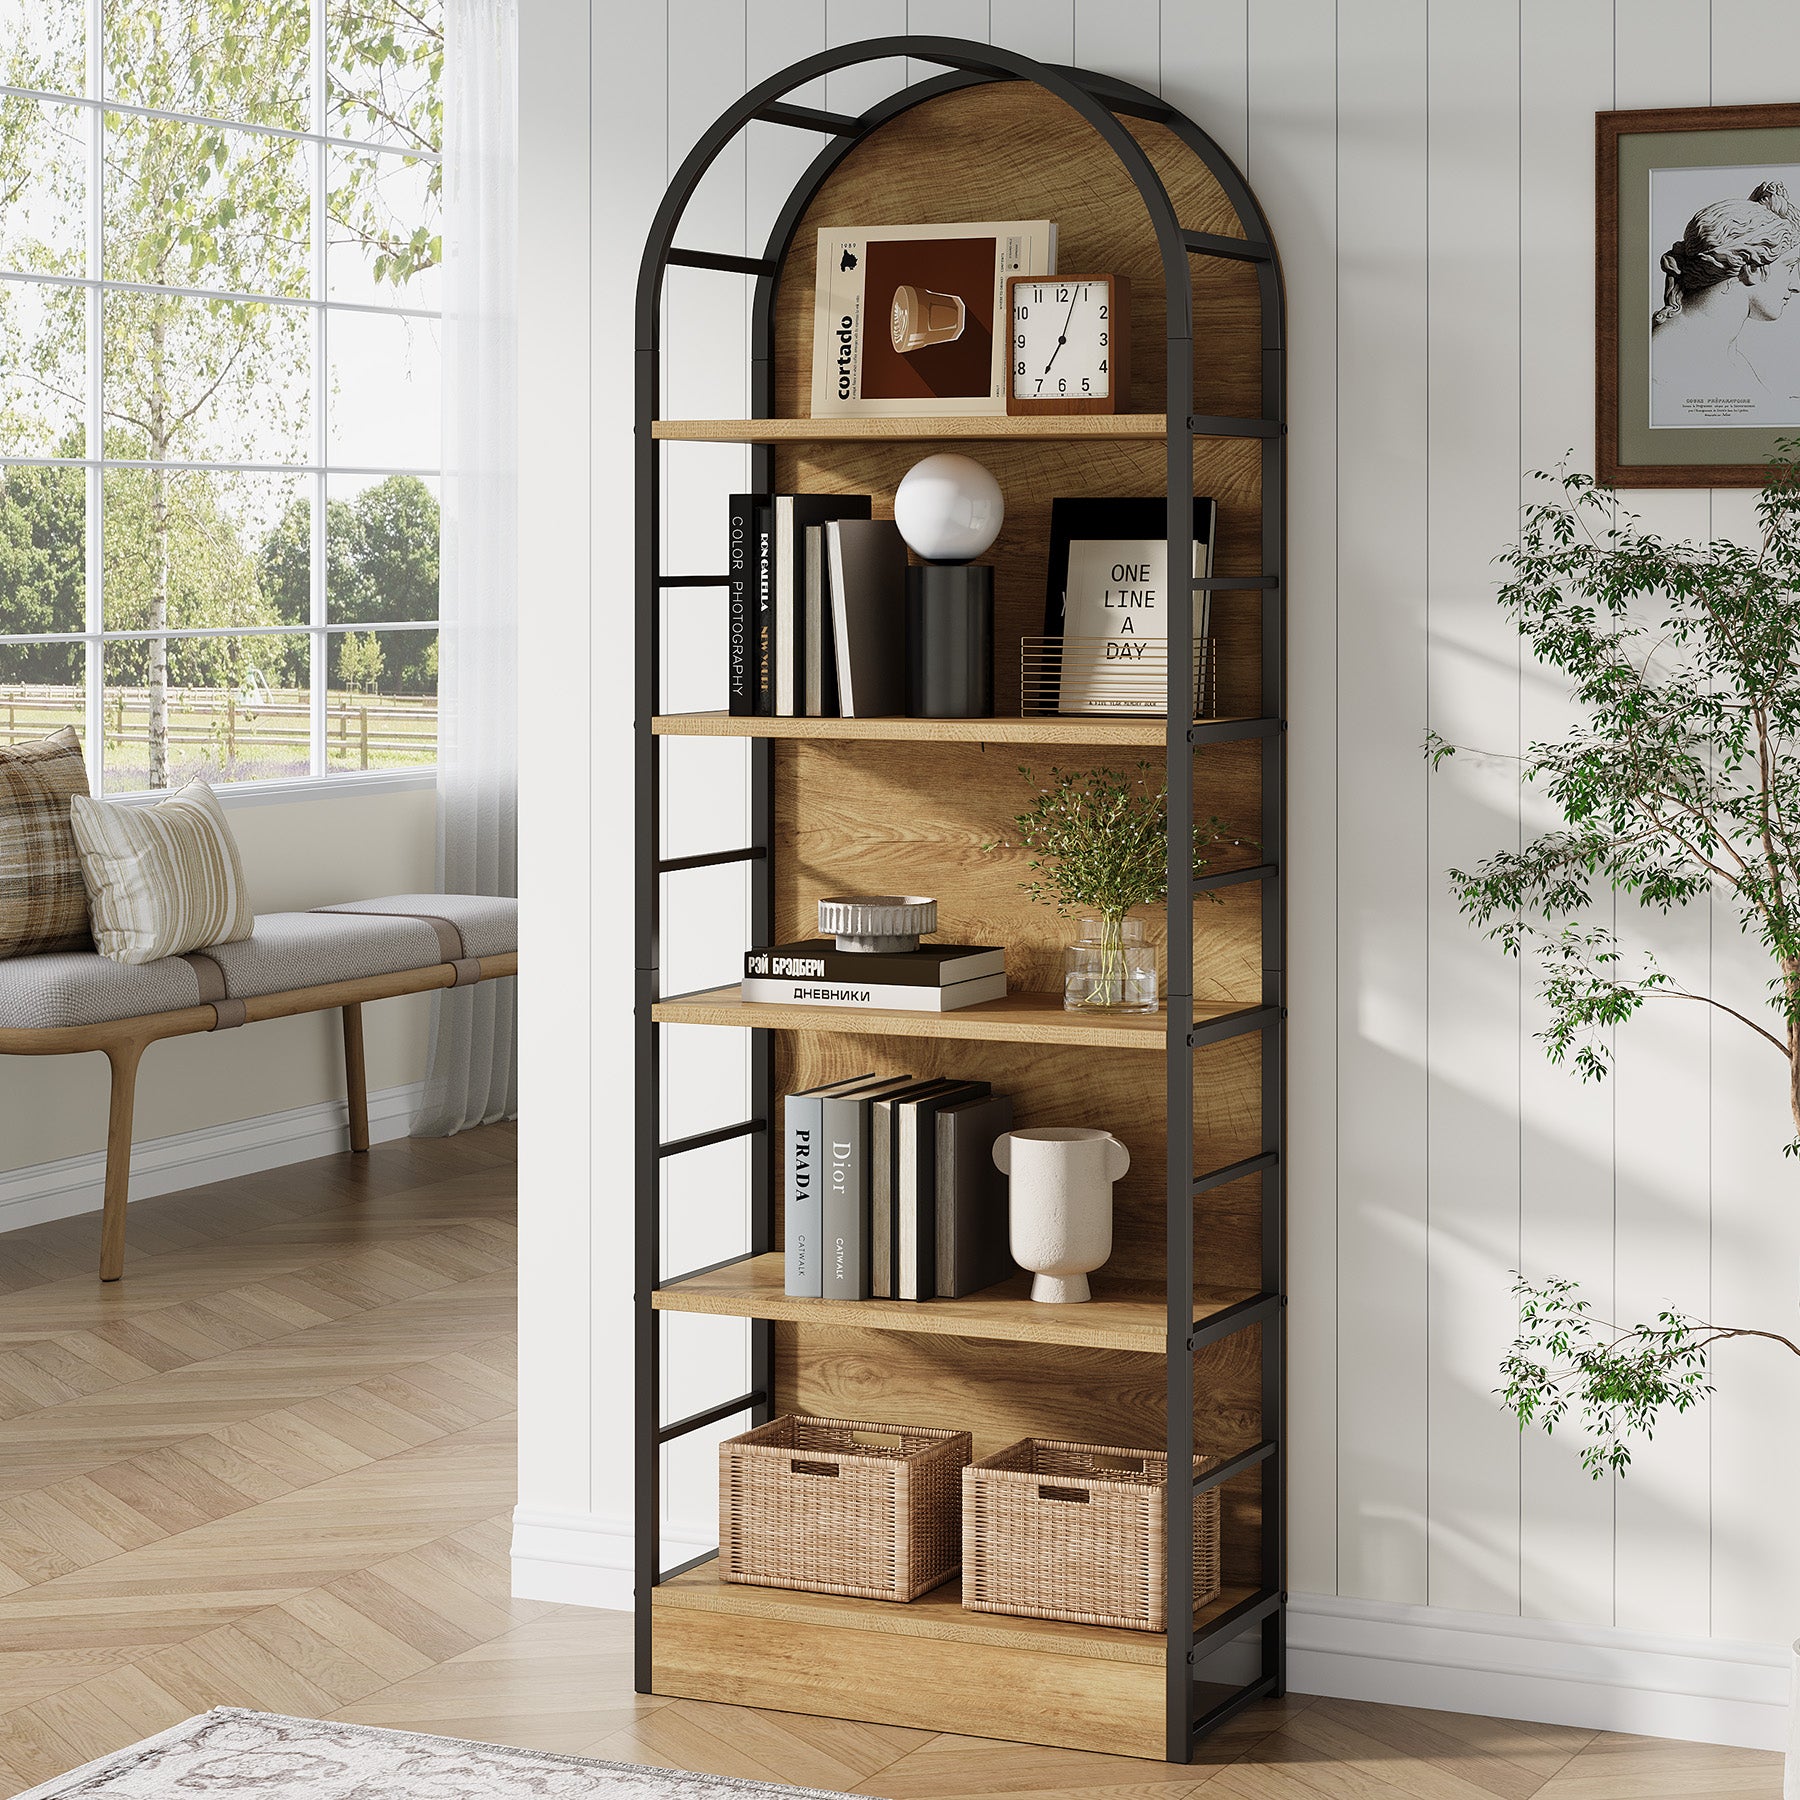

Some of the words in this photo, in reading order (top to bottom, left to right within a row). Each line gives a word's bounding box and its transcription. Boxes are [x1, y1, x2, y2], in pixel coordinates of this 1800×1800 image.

[1033, 288, 1043, 303] 11
[1056, 288, 1069, 303] 12
[1083, 288, 1088, 302] 1
[1017, 307, 1029, 321] 10
[1099, 305, 1108, 320] 2
[1017, 334, 1026, 349] 9
[1099, 332, 1108, 347] 3
[836, 315, 853, 400] cortado
[1099, 359, 1108, 374] 4
[1017, 362, 1026, 376] 8
[1035, 378, 1044, 393] 7
[1058, 378, 1067, 393] 6
[1081, 378, 1090, 392] 5
[732, 516, 744, 570] COLOR
[760, 532, 769, 558] RON
[1111, 564, 1151, 583] ONE
[760, 558, 769, 612] GALELLA
[1104, 590, 1156, 608] LINE
[1121, 616, 1135, 634] A
[732, 581, 744, 696] PHOTOGRAPHY
[1106, 642, 1147, 660] DAY
[747, 953, 768, 974] РЭЙ
[773, 957, 825, 977] БРЭДБЕРИ
[793, 987, 870, 1002] ДНЕВНИКИ
[795, 1129, 810, 1202] PRADA
[832, 1141, 851, 1194] Dior
[797, 1235, 806, 1276] CATWALK
[836, 1238, 845, 1280] CATWALK
